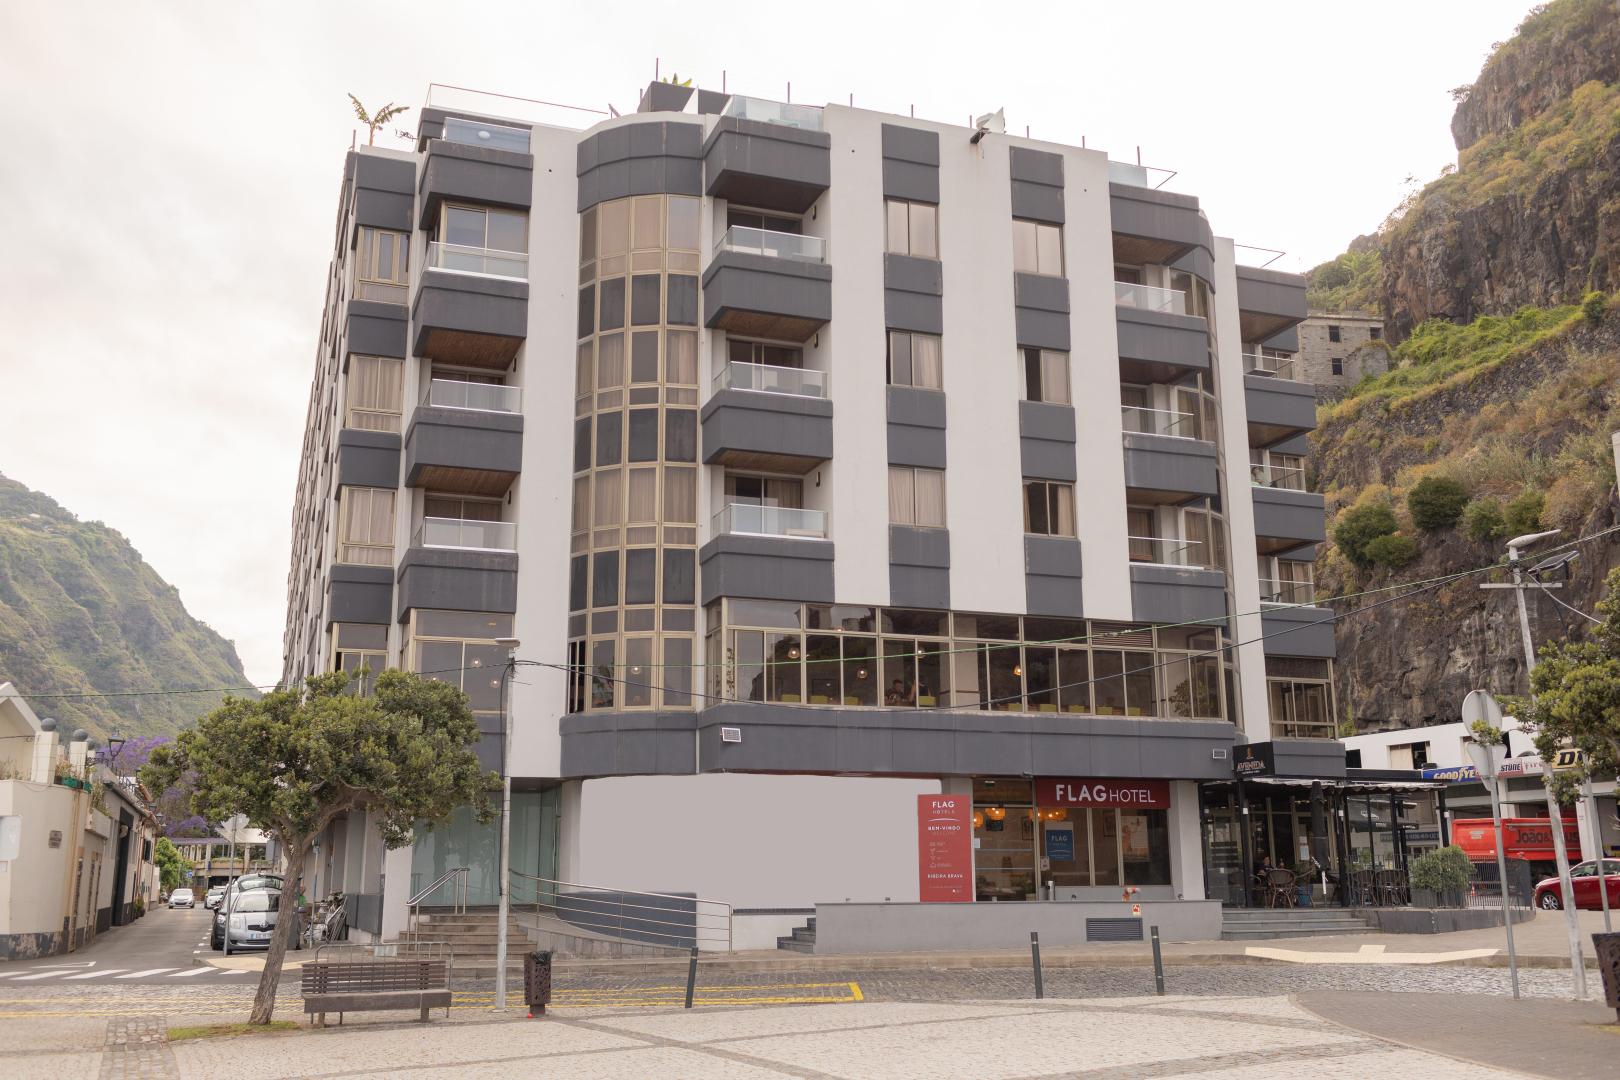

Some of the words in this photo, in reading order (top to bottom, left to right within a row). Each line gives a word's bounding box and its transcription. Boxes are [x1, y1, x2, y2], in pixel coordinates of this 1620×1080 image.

[1500, 763, 1521, 772] STONE
[1055, 784, 1107, 802] FLAG
[1109, 789, 1156, 803] HOTEL
[932, 800, 955, 808] FLAG
[1051, 834, 1068, 842] FLAG
